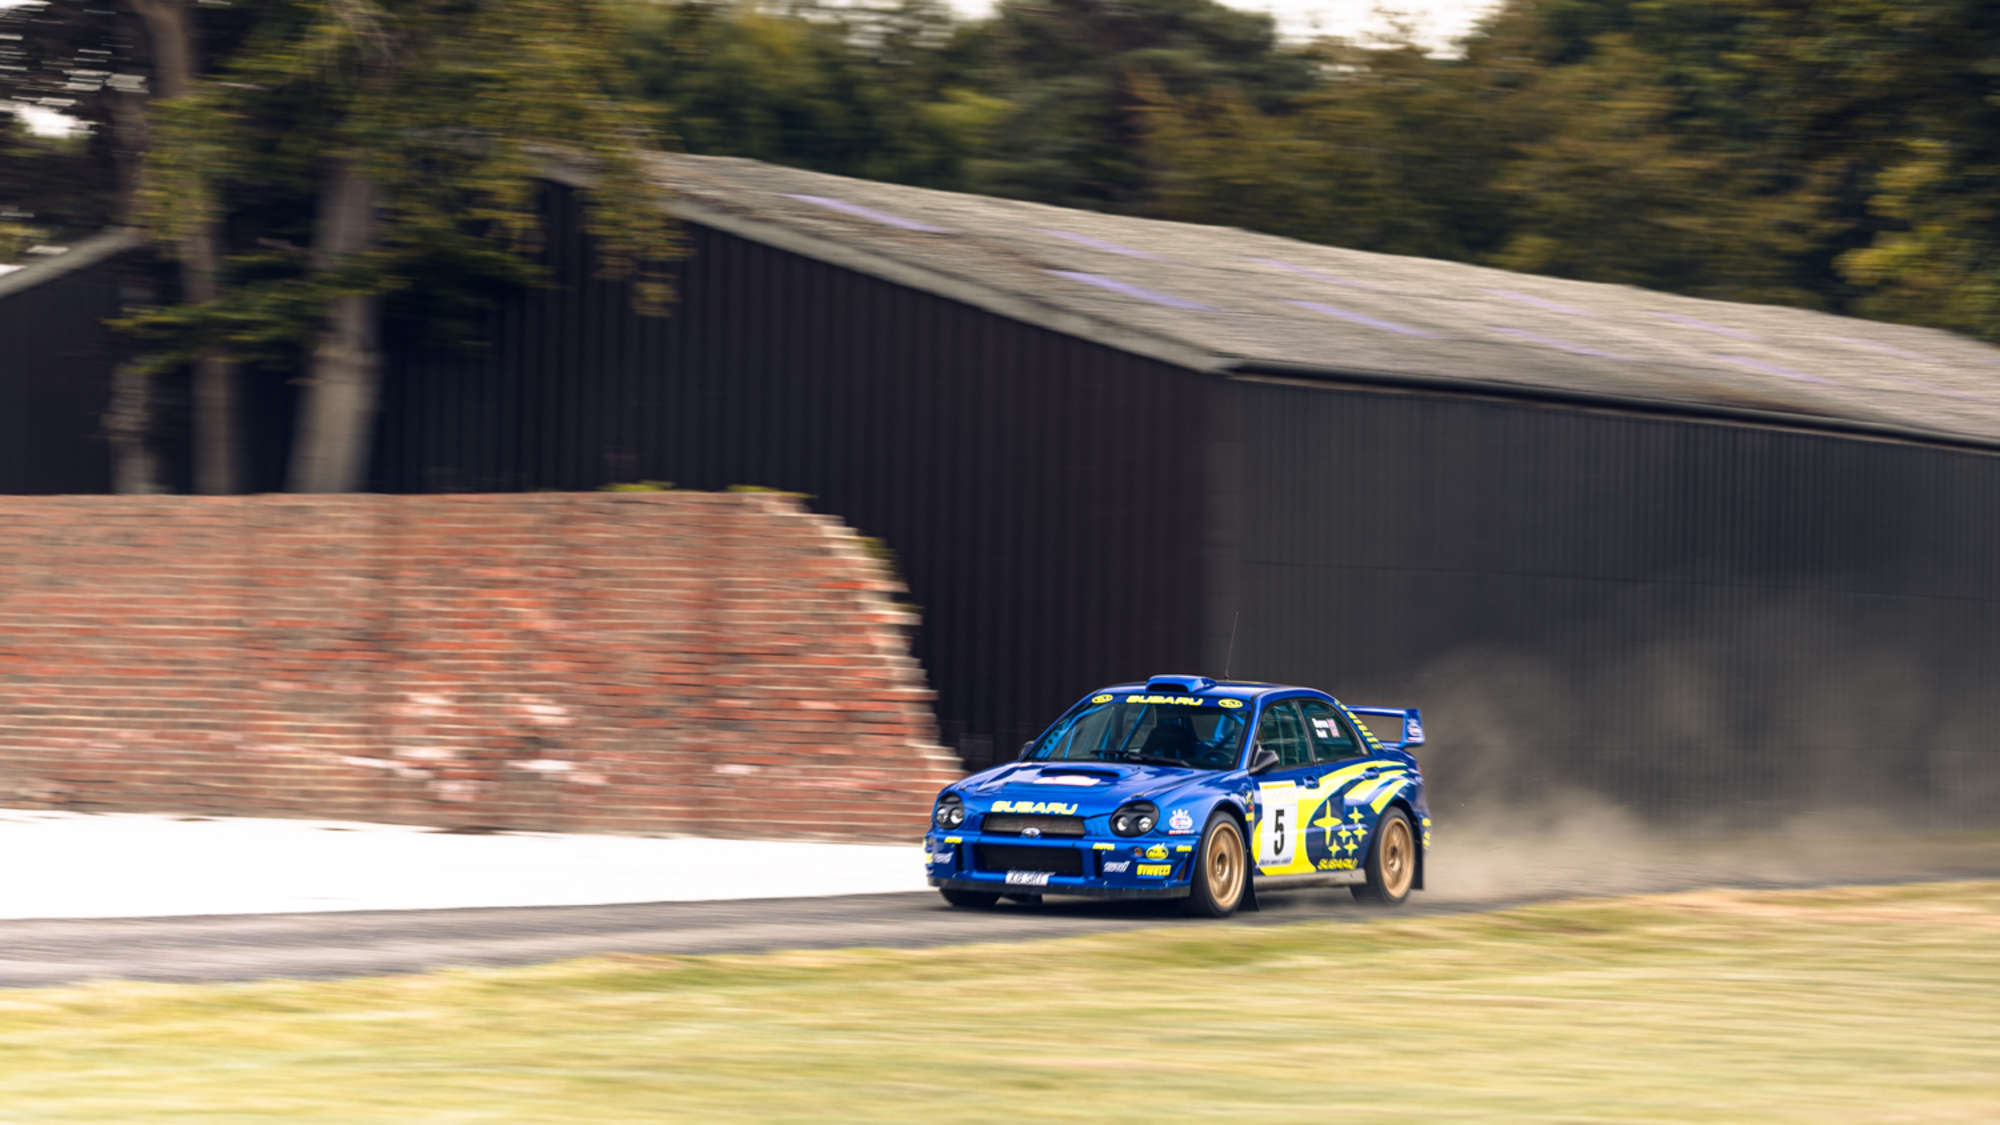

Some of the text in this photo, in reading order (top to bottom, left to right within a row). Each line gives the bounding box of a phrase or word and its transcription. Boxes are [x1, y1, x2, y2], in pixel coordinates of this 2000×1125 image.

[1126, 695, 1203, 706] SUBARU
[990, 800, 1079, 815] SUBARU
[1274, 809, 1285, 856] 5
[1317, 857, 1358, 870] SUBARU
